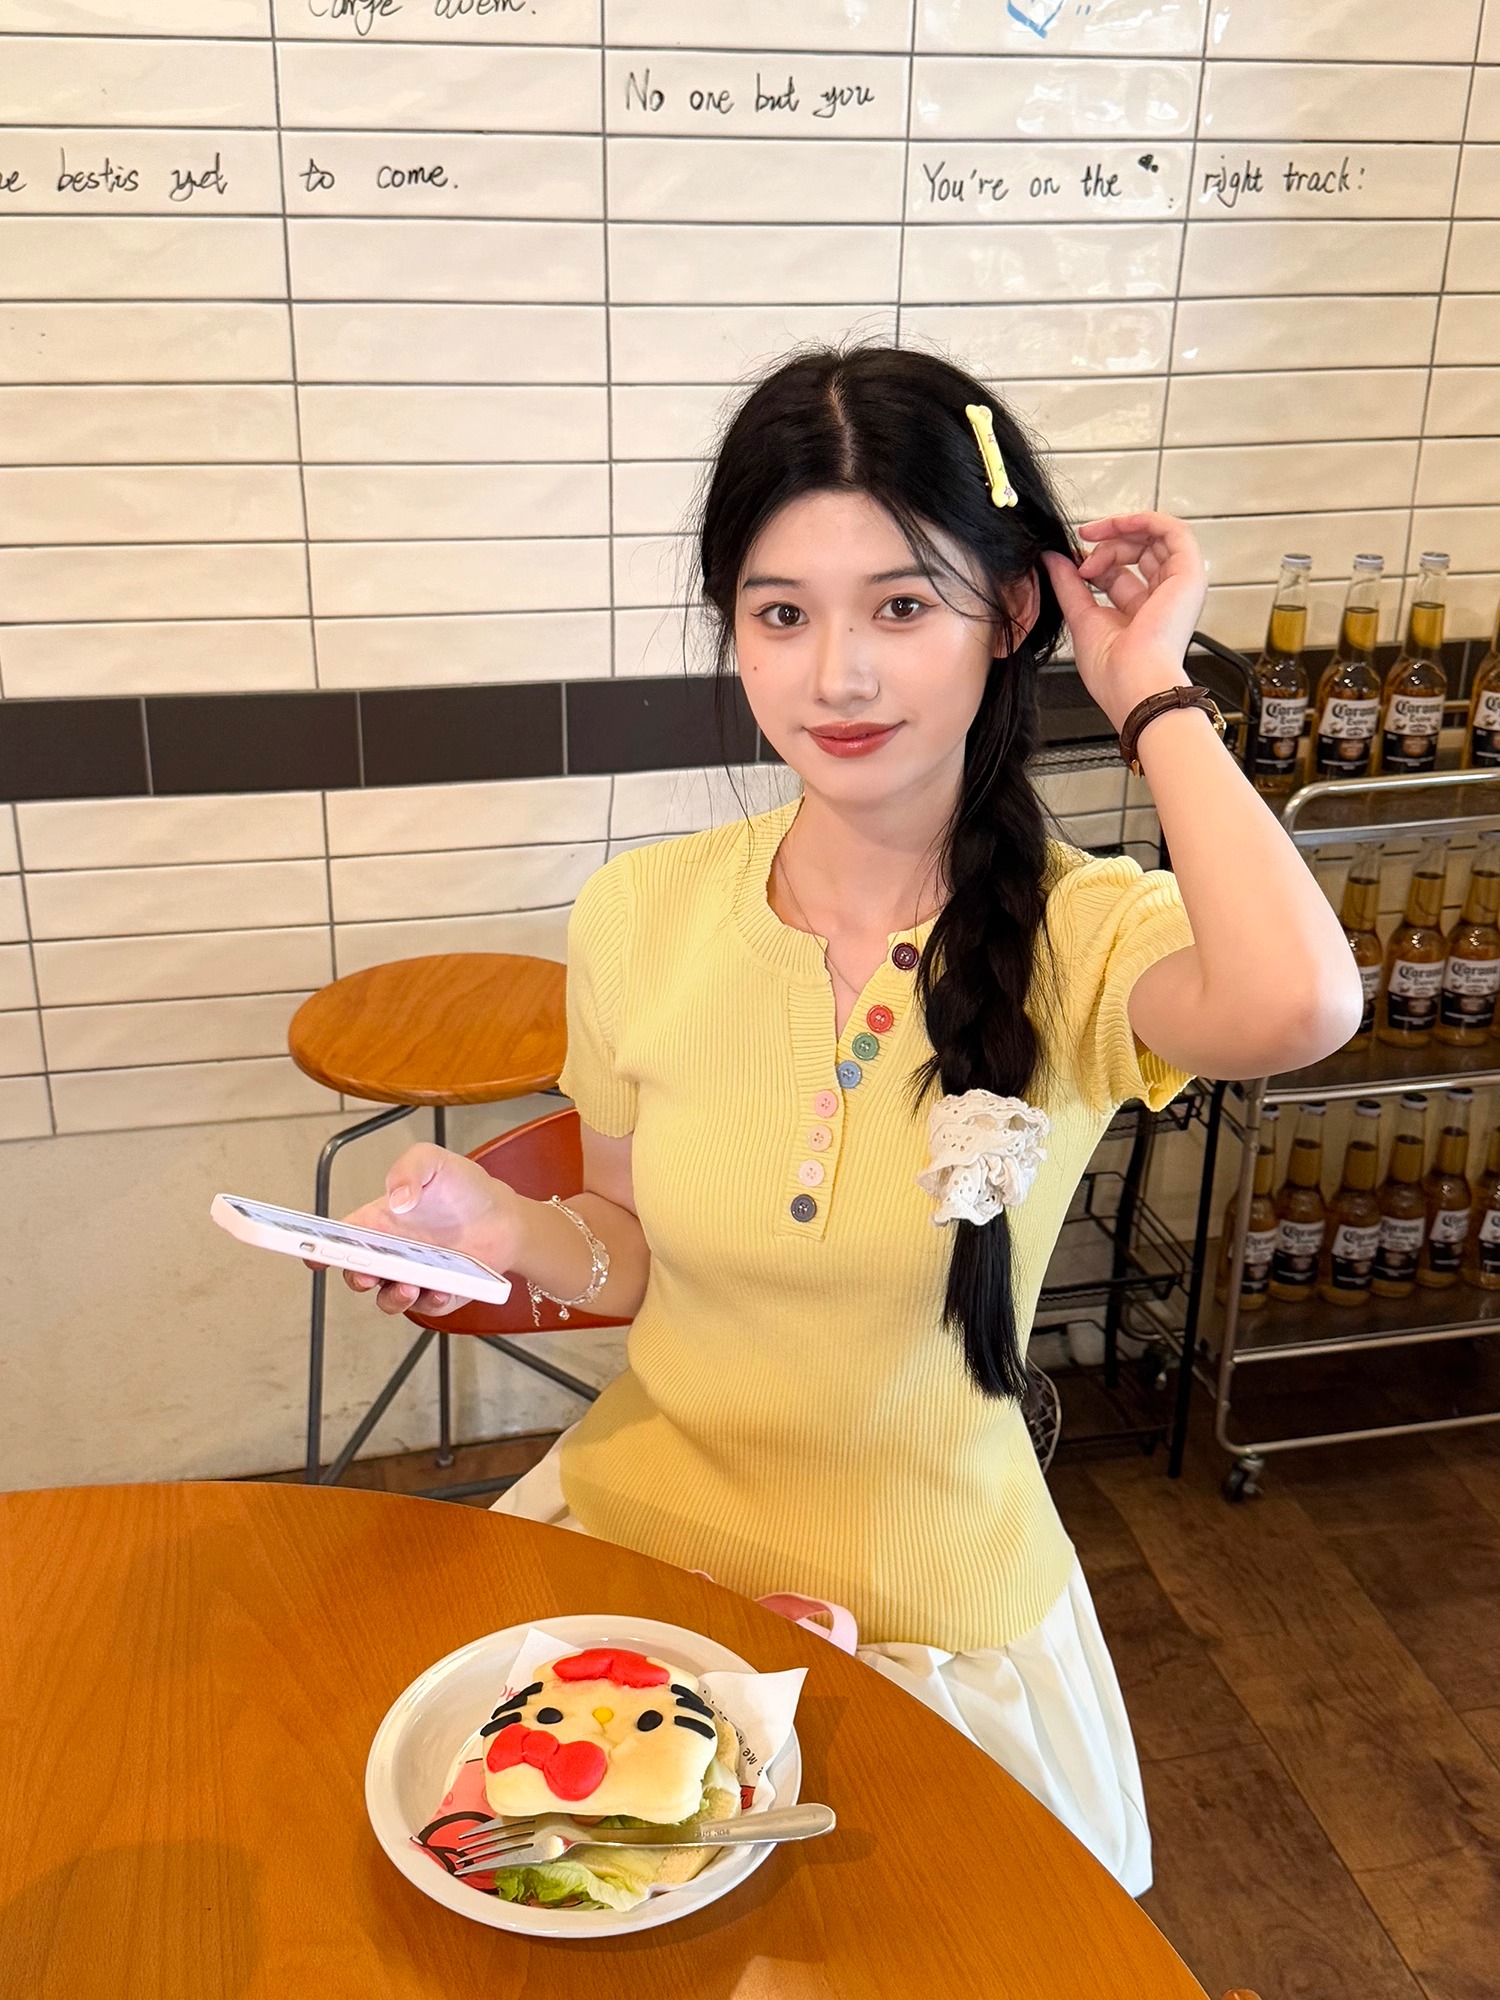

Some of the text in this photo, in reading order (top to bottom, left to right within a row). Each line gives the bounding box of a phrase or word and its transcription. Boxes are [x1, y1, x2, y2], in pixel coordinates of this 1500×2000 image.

[626, 69, 875, 118] No one but you
[299, 158, 335, 192] to
[923, 161, 1010, 203] You're
[1029, 177, 1061, 198] on
[1080, 163, 1123, 198] the
[1203, 155, 1264, 208] right
[1342, 1228, 1380, 1243] Cor
